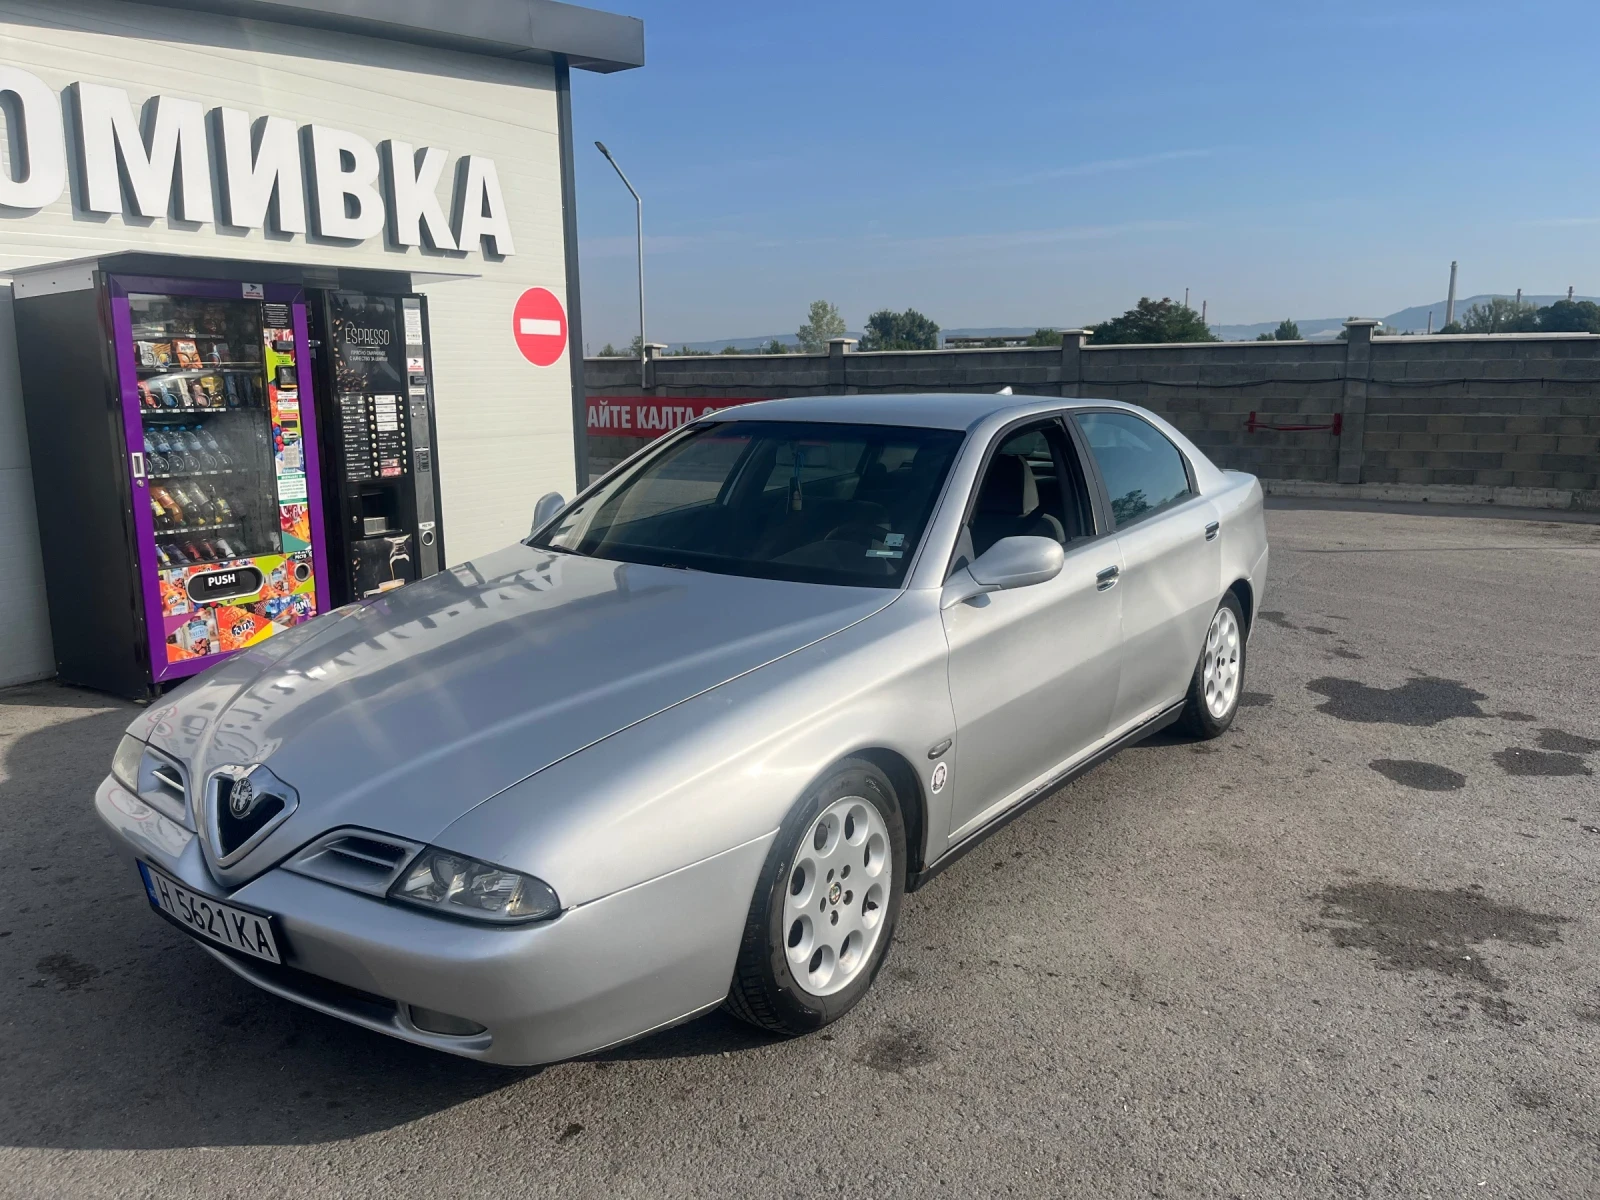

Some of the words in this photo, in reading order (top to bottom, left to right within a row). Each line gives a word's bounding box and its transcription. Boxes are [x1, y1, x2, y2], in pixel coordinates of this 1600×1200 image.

[345, 322, 390, 345] ESPRESSO
[588, 400, 632, 429] АЙТЕ
[637, 406, 695, 430] КАЛТА
[208, 574, 236, 587] PUSH
